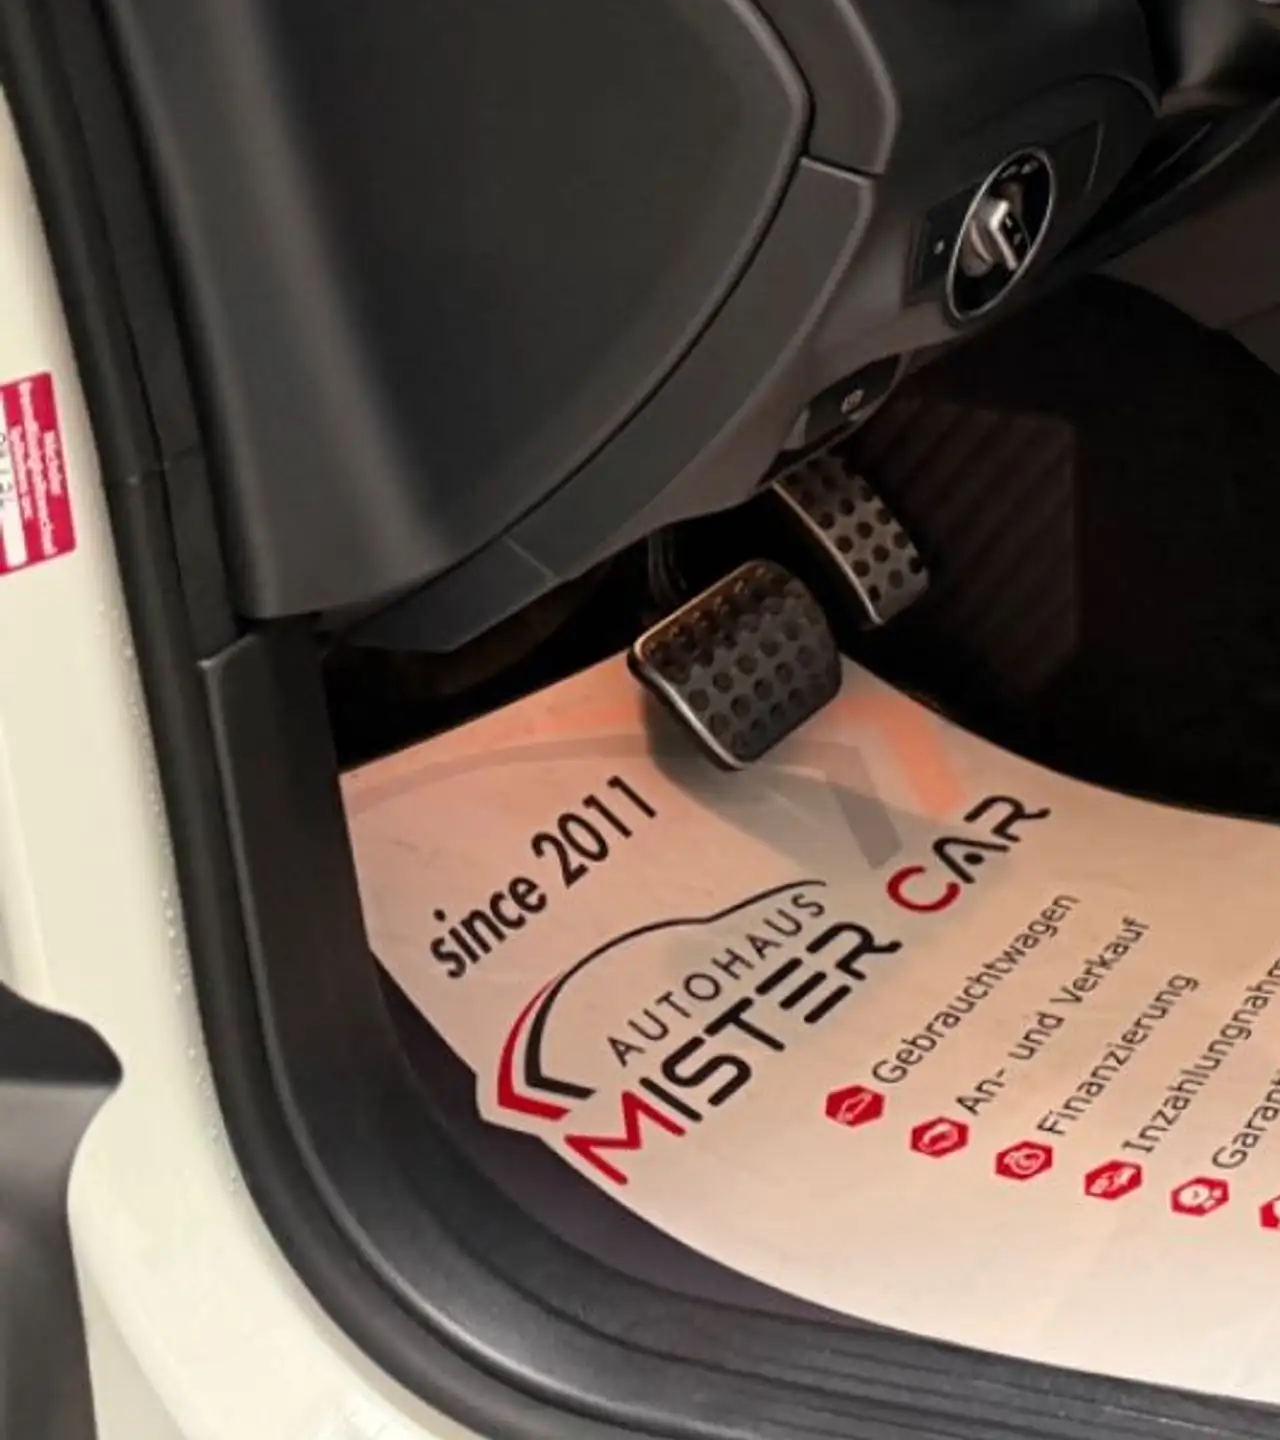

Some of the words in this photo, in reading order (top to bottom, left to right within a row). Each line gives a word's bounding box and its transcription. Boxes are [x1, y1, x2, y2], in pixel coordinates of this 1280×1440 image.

[429, 874, 548, 979] since
[530, 775, 658, 889] 2011
[564, 921, 903, 1186] MISTER
[886, 794, 1052, 915] CAR
[606, 892, 827, 1068] AUTOHAUS
[871, 893, 1081, 1085] Gebrauchtwagen
[955, 1068, 1006, 1117] An-
[1008, 1010, 1066, 1062] und
[1049, 915, 1151, 1007] Verkauf
[1036, 972, 1200, 1137] Finanzierung
